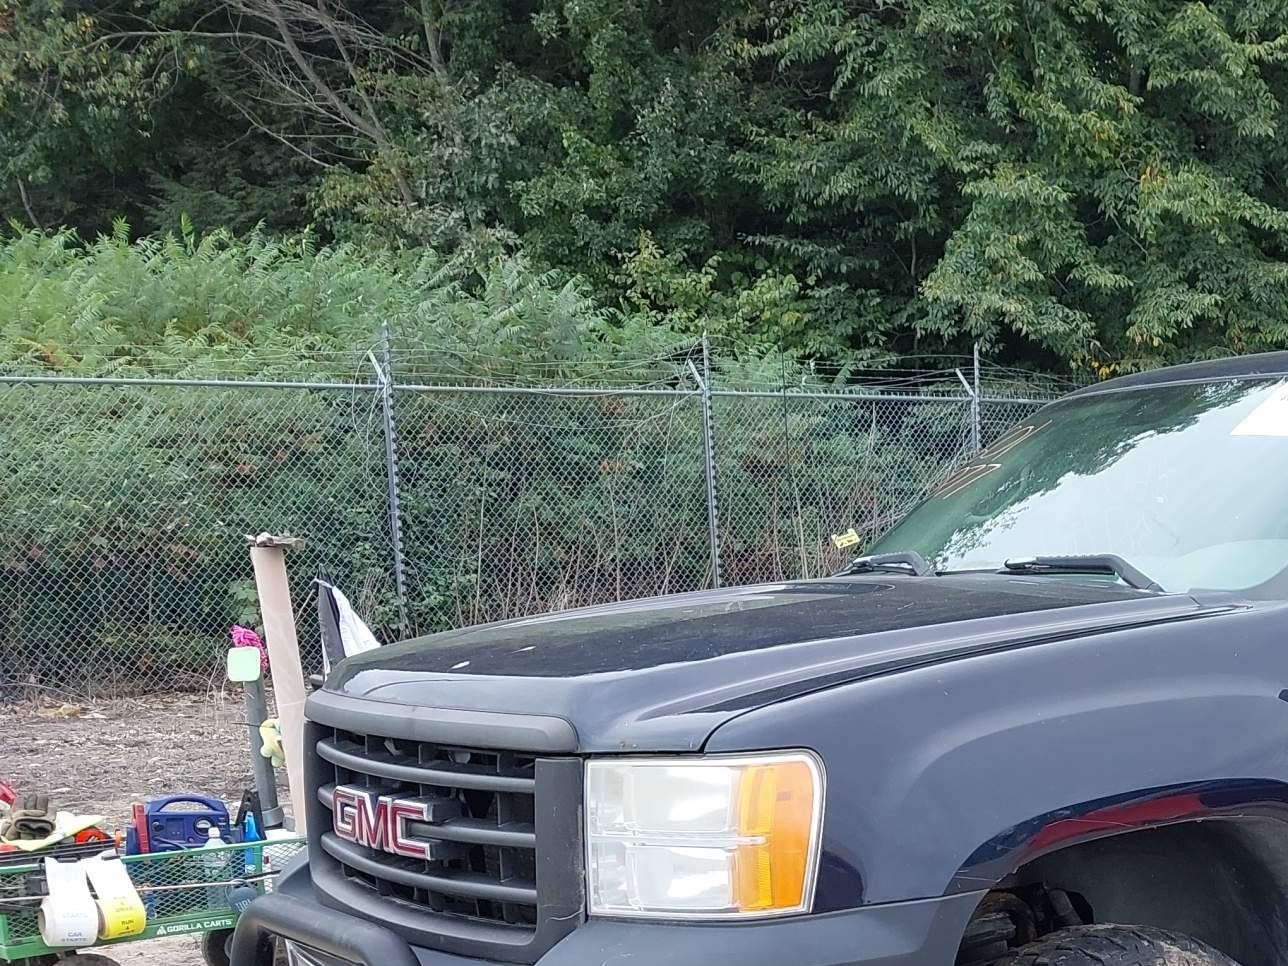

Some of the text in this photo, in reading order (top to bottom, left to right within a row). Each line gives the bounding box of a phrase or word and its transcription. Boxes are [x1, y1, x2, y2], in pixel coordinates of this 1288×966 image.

[332, 785, 431, 861] GMC
[167, 918, 232, 933] GORILLA CARTS
